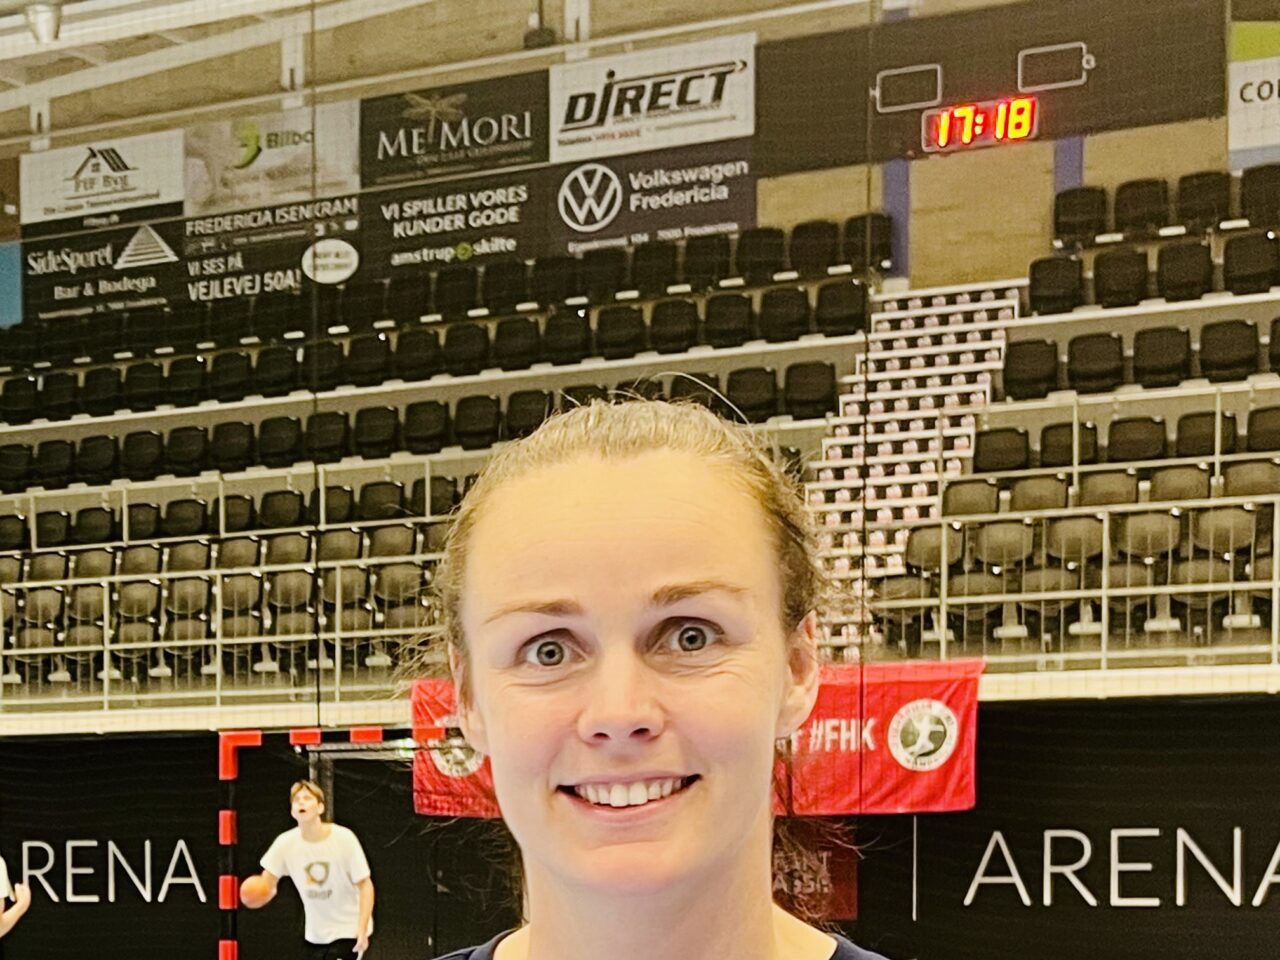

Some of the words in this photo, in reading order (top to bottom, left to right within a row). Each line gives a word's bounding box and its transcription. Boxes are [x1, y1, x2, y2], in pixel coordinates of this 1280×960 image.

[1240, 79, 1280, 103] CO
[377, 127, 427, 160] ME
[440, 111, 532, 150] MORI
[937, 98, 1034, 147] 17:18
[628, 160, 749, 191] Volkswagen
[381, 203, 400, 221] VI
[402, 194, 468, 218] SPILLER
[469, 185, 529, 208] VORES
[629, 184, 729, 212] Fredericia
[185, 210, 273, 237] FREDERICIA
[275, 197, 359, 224] ISENKRAM
[393, 213, 466, 238] KUNDER
[468, 206, 520, 228] GODE
[187, 261, 200, 277] VI
[202, 257, 225, 275] SES
[83, 282, 95, 296] &
[187, 274, 261, 301] VEJLEVEJ
